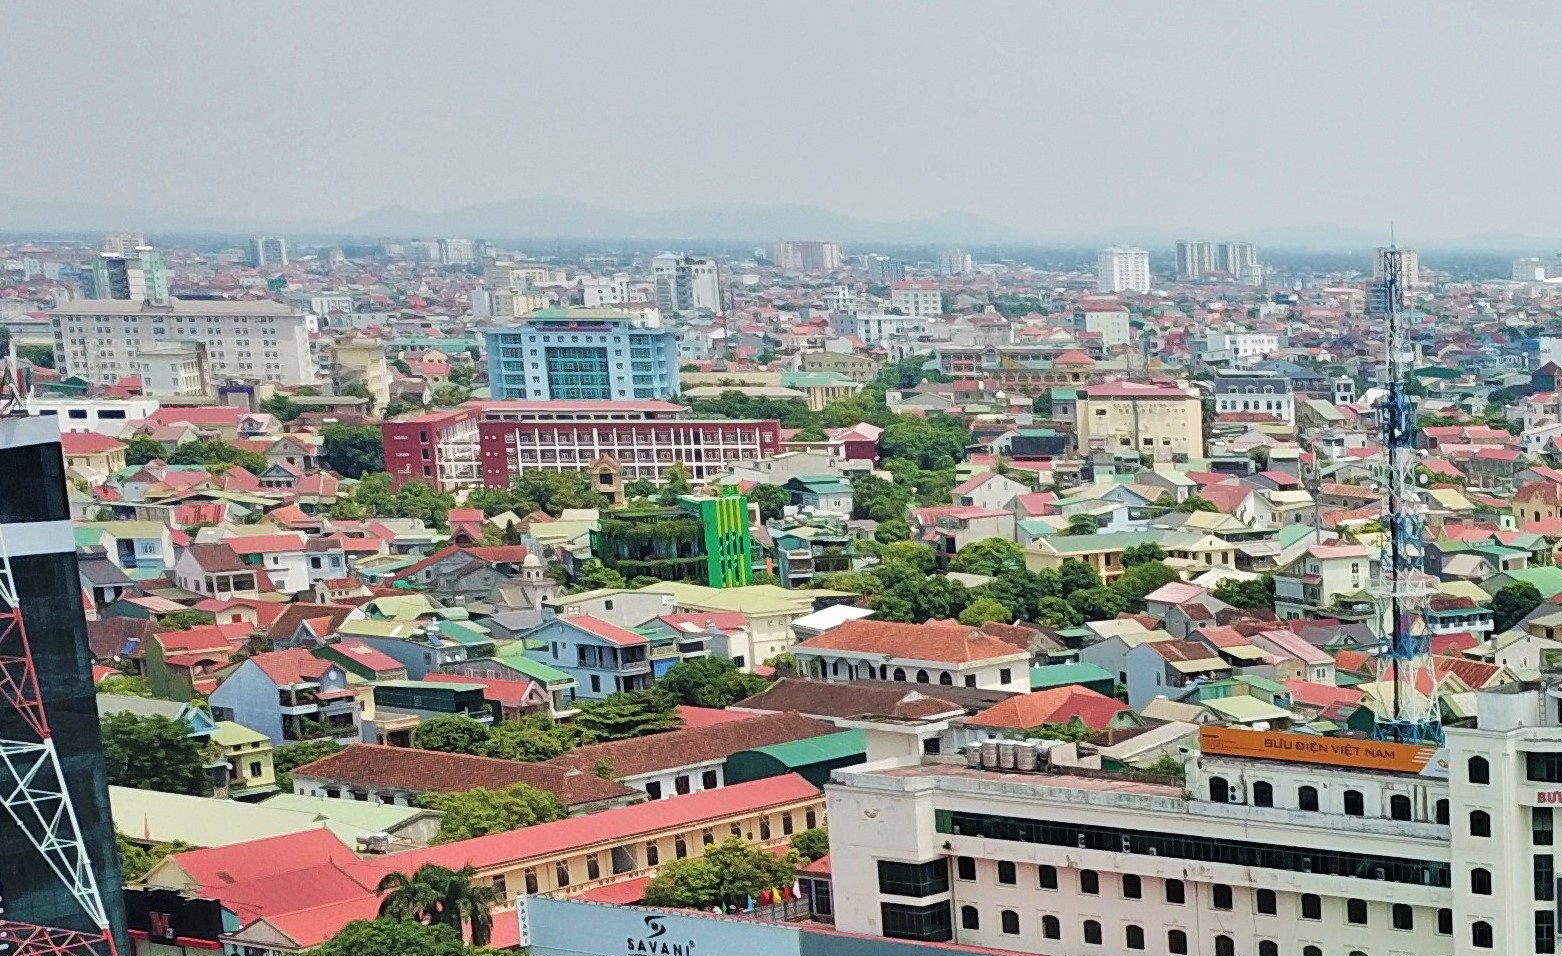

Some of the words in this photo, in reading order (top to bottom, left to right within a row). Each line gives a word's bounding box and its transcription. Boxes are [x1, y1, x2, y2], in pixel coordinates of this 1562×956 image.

[1264, 738, 1293, 750] BƯU
[1295, 739, 1329, 755] ĐIỆN
[1331, 742, 1362, 757] VIỆT
[1365, 747, 1396, 759] NAM
